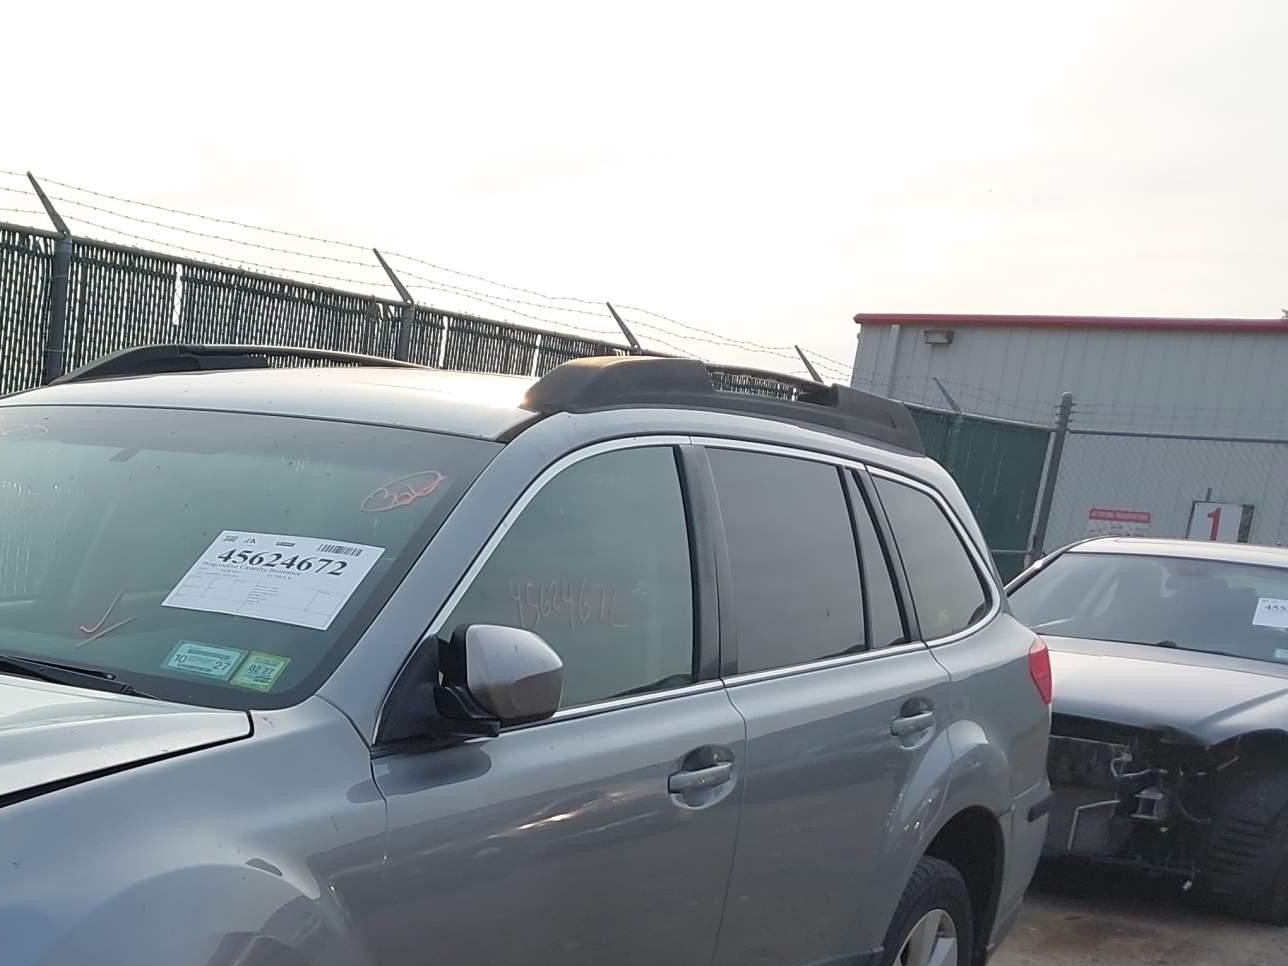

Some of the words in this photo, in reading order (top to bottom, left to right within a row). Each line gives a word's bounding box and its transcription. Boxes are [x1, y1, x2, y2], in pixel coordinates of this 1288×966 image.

[1208, 507, 1221, 541] 1
[217, 548, 348, 576] 45624672
[174, 654, 188, 664] 10
[213, 661, 231, 671] 27
